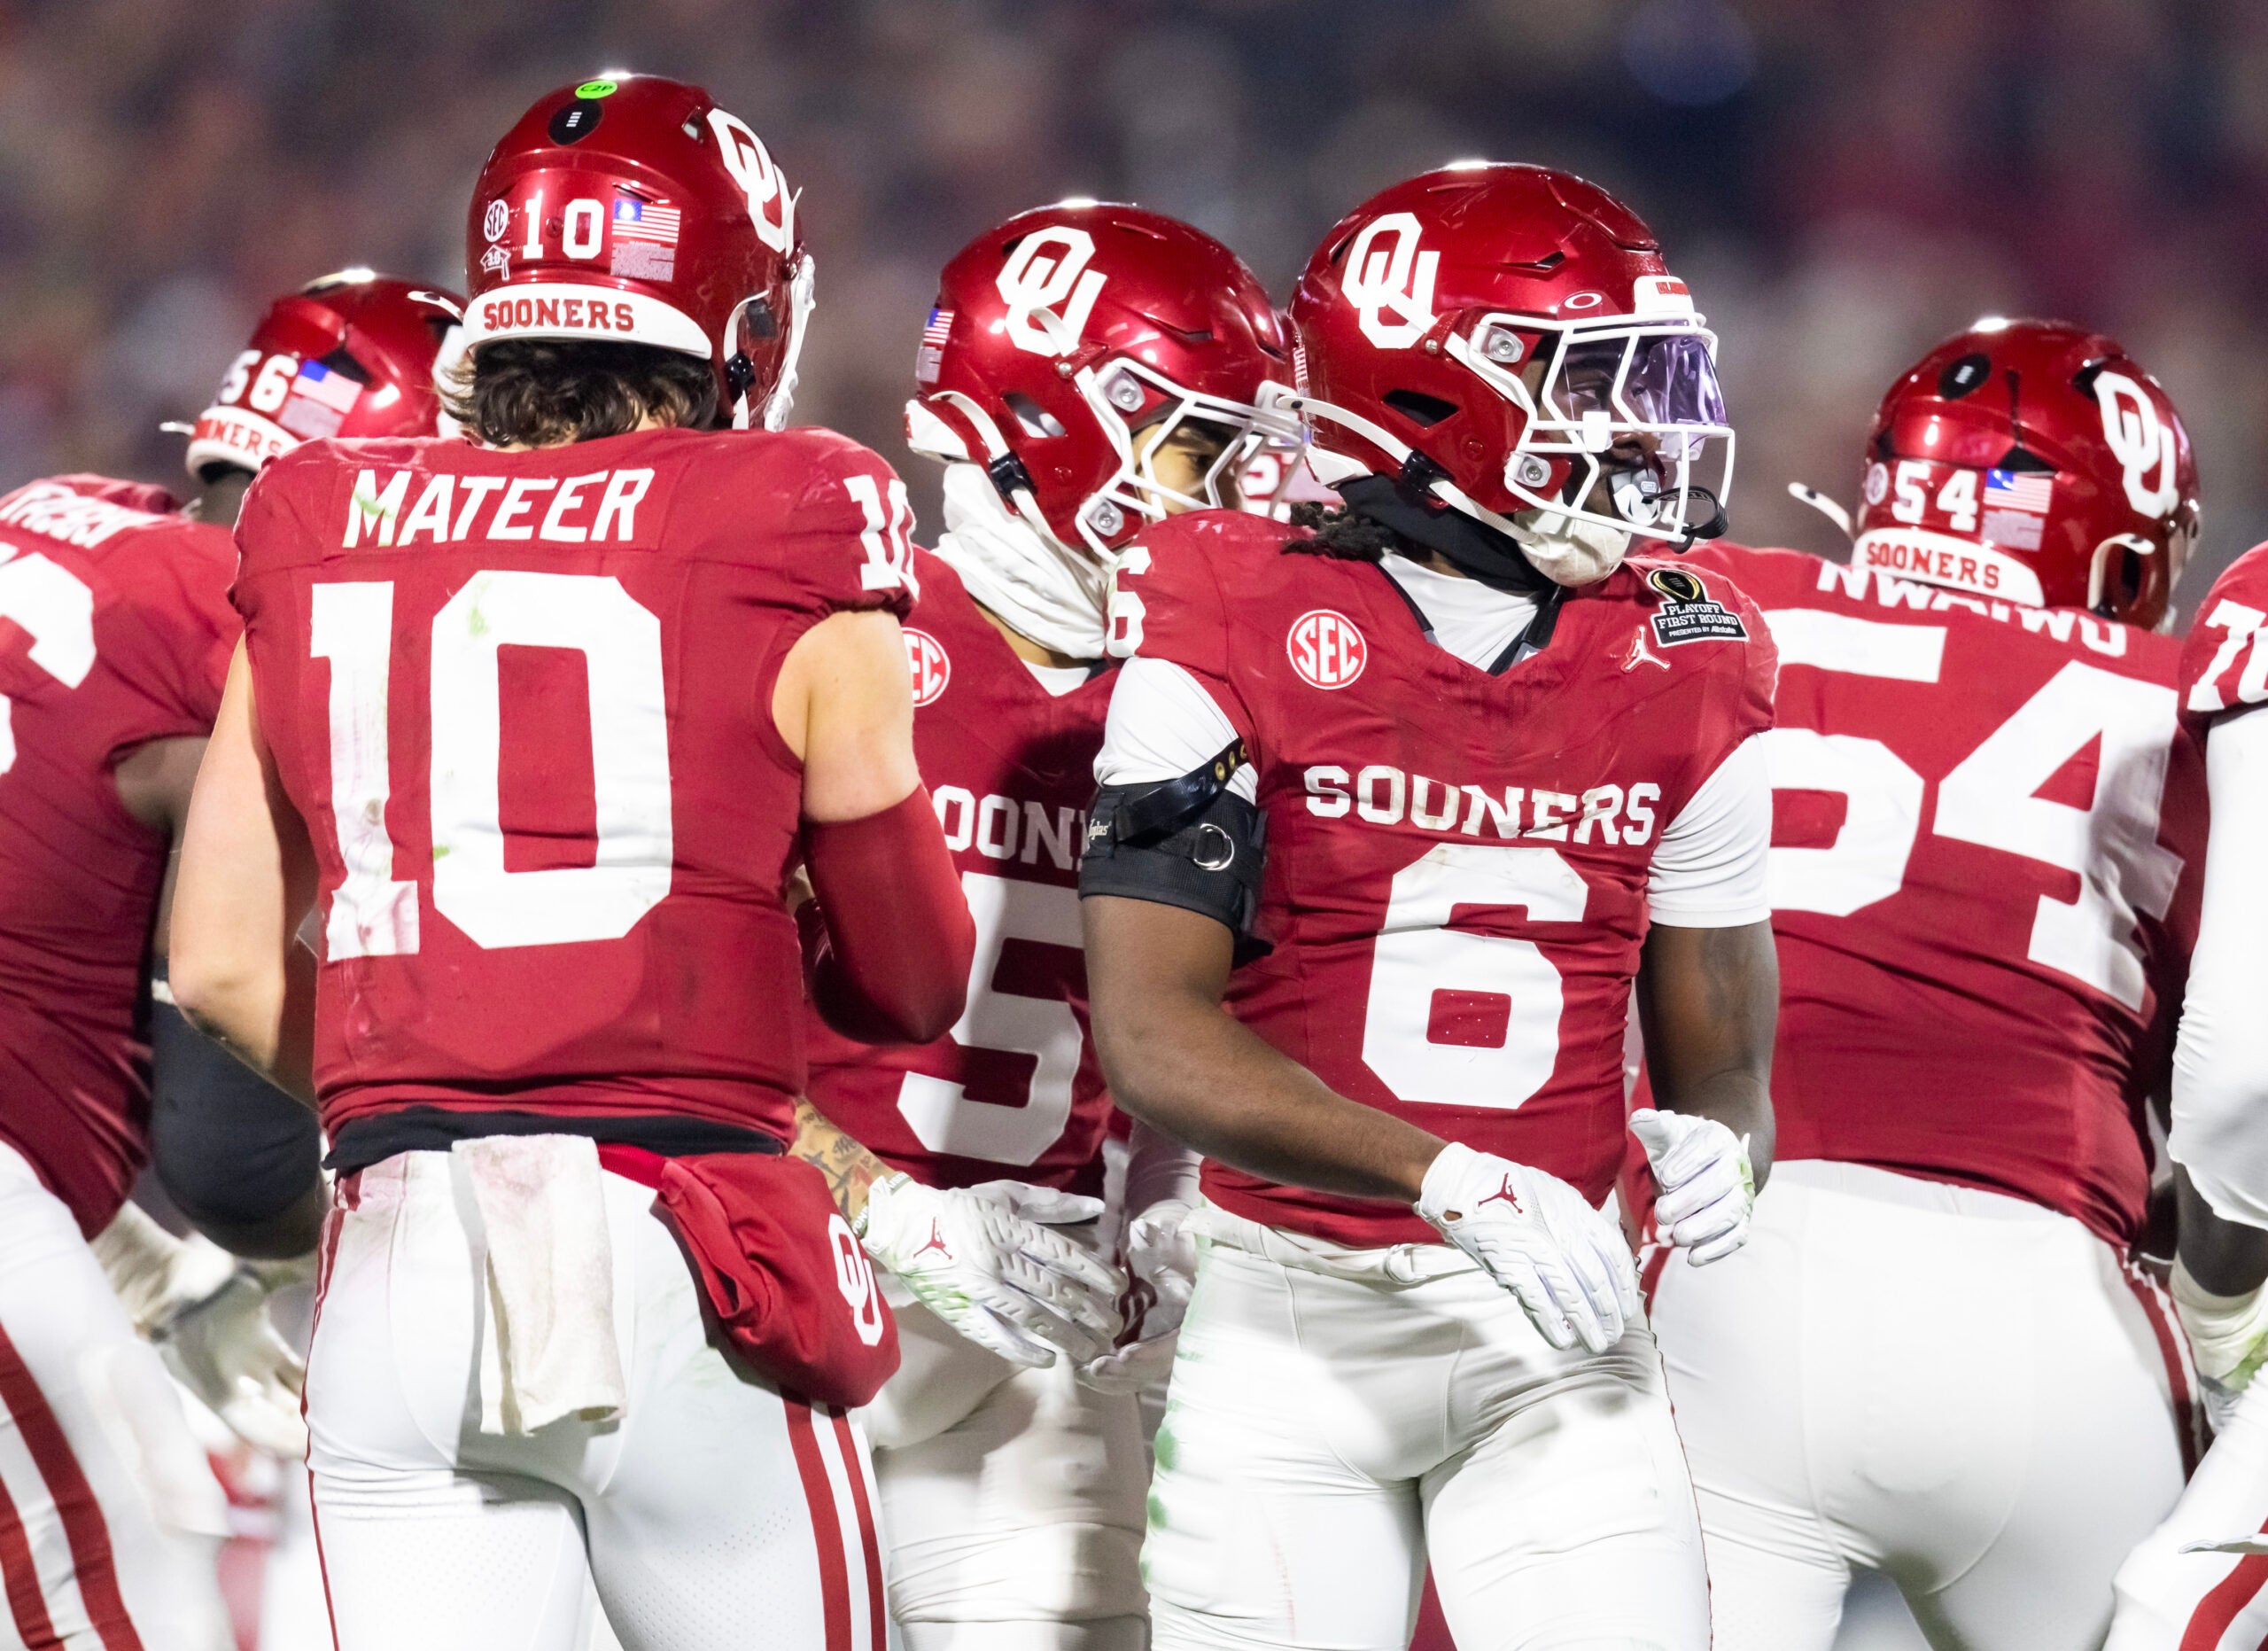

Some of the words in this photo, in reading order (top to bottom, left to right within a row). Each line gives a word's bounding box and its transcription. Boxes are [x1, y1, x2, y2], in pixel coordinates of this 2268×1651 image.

[522, 189, 605, 260] 10
[483, 298, 634, 332] SOONERS
[342, 468, 656, 549] MATEER
[1891, 460, 1978, 532] 54
[1105, 545, 1152, 658] 6
[1866, 541, 2000, 590] SOONERS
[1658, 615, 1696, 629] FIRST
[1697, 613, 1738, 626] ROUND
[1667, 604, 1720, 615] PLAYOFF
[902, 635, 943, 699] EC
[1296, 619, 1359, 683] SEC
[310, 570, 673, 962] 10
[1303, 765, 1662, 846] SOONERS
[1762, 607, 2186, 1013] 54
[1361, 842, 1589, 1110] 6
[896, 870, 1092, 1168] 5
